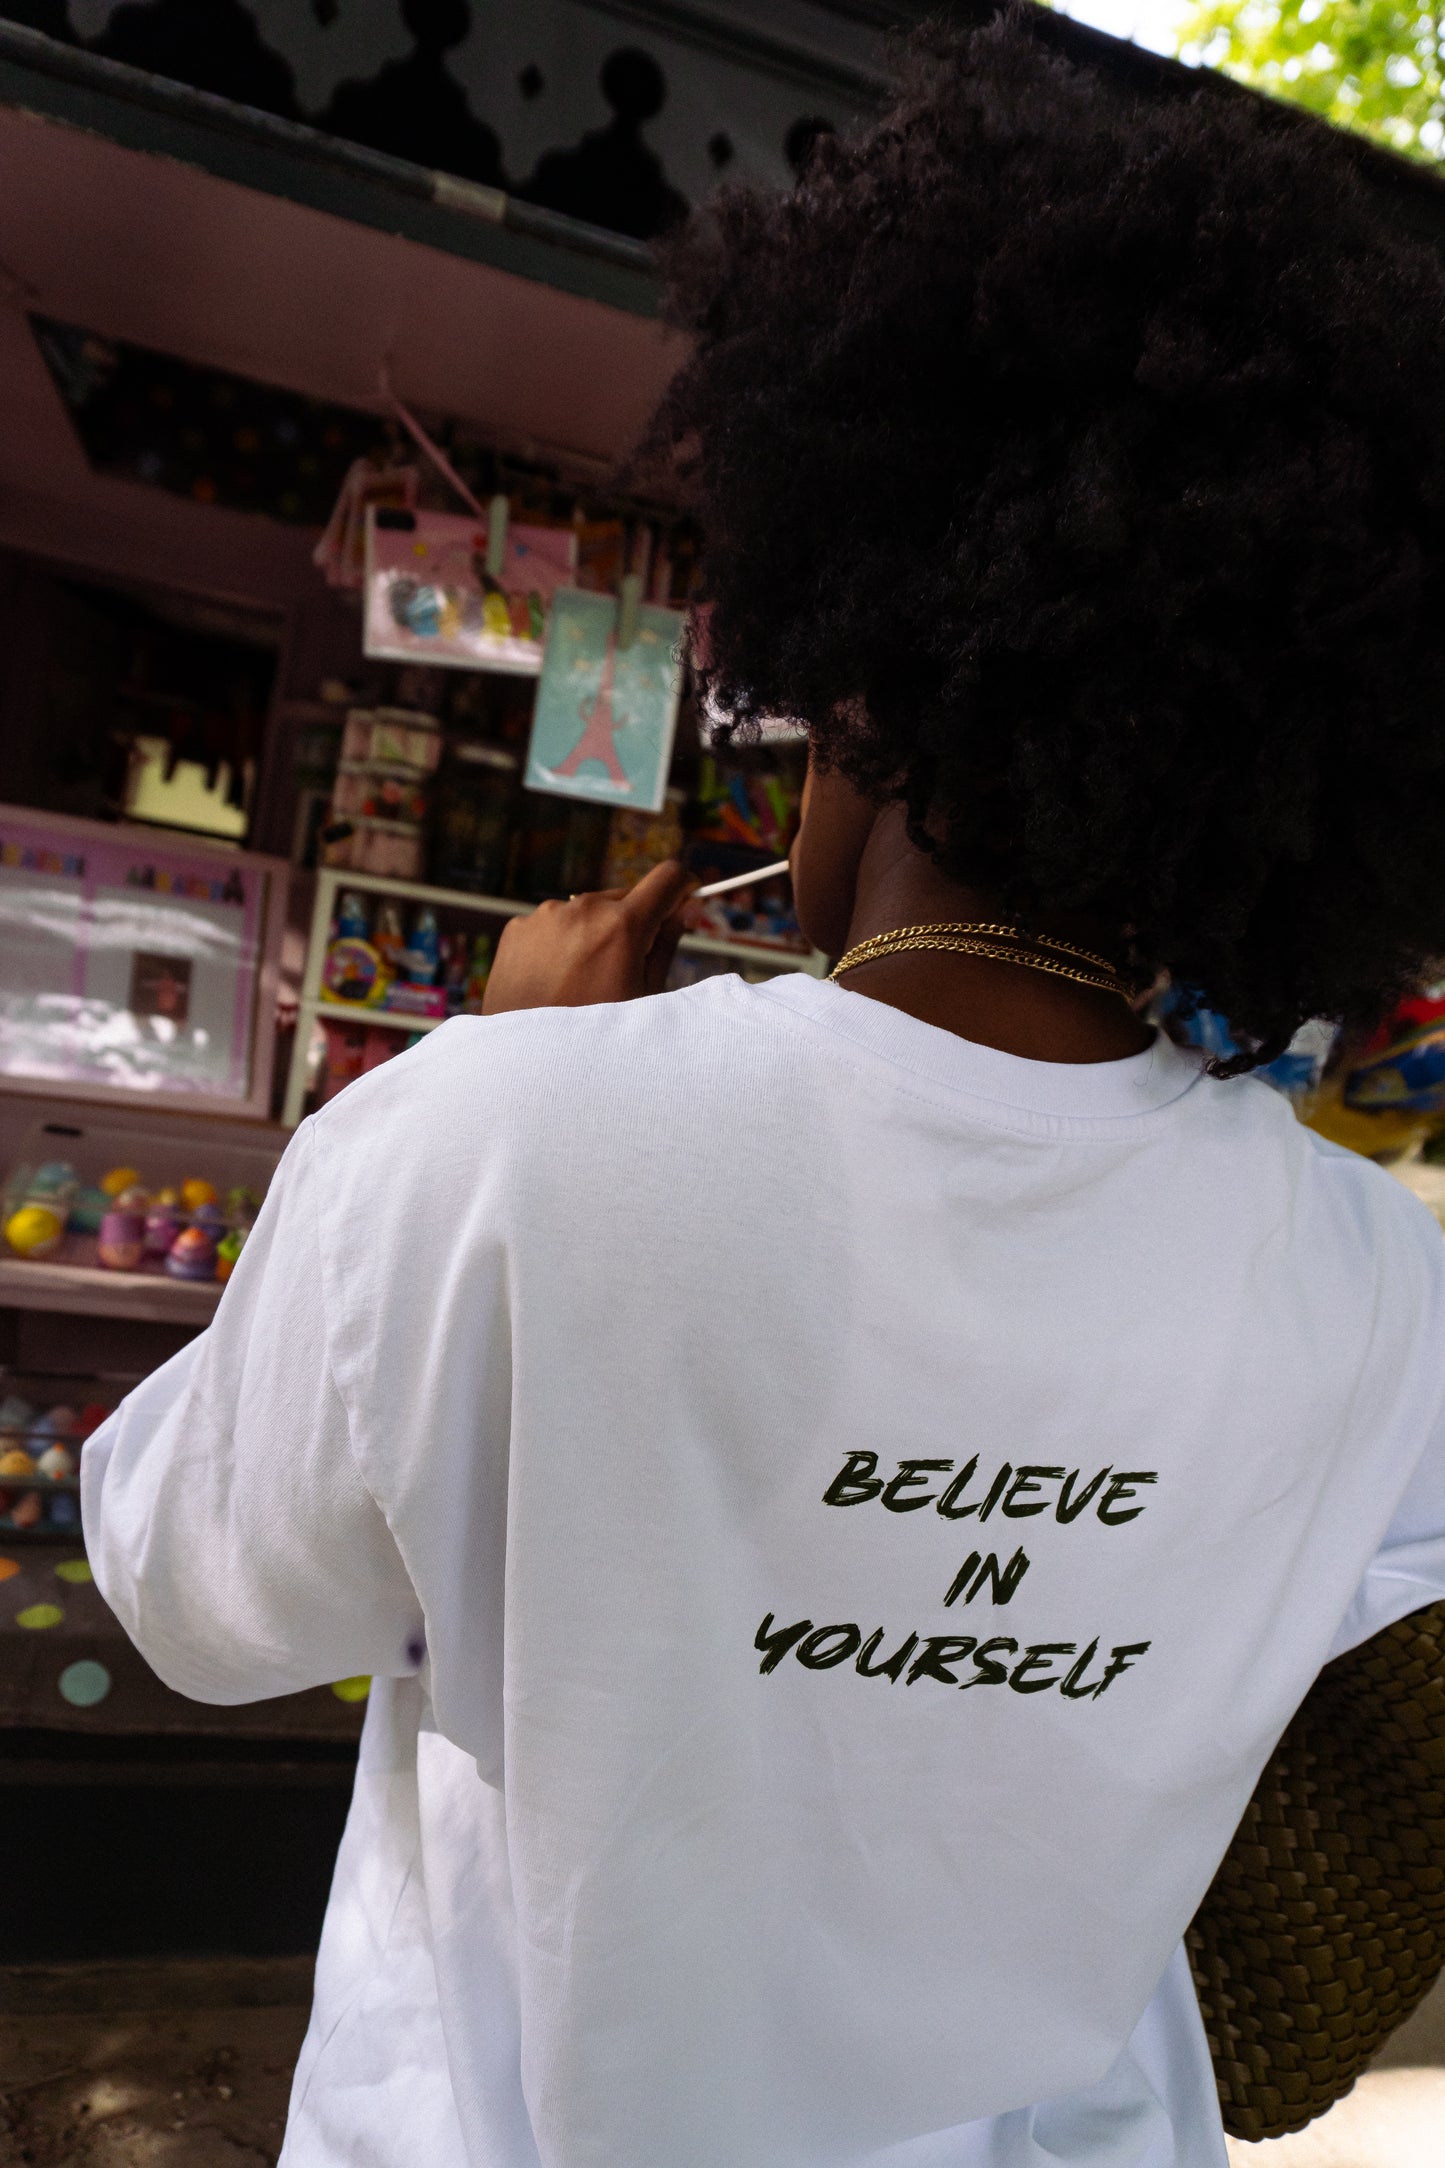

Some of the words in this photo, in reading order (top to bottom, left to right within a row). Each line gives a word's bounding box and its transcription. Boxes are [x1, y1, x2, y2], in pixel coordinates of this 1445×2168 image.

[822, 1451, 1158, 1526] BELIEVE
[943, 1546, 1031, 1607] IN
[754, 1612, 1152, 1700] YOURSELF
